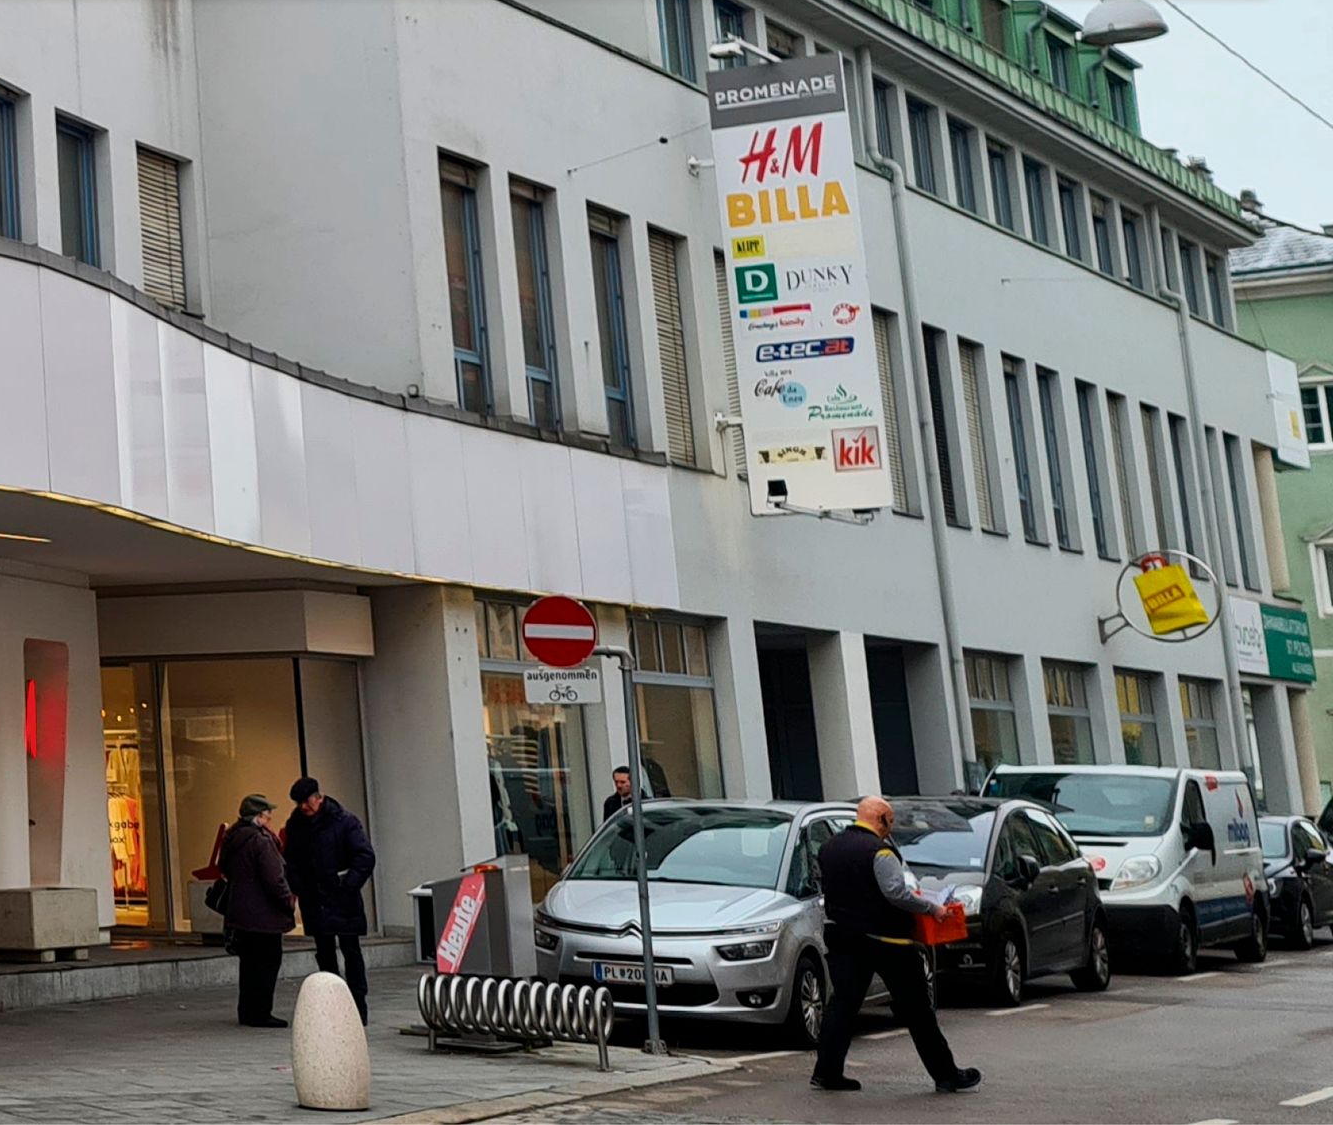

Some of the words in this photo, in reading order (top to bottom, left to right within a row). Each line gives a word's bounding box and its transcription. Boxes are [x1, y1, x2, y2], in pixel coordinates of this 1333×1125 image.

[715, 75, 836, 105] PROMENADE
[739, 121, 823, 183] H&M
[726, 181, 850, 229] BILLA
[744, 269, 769, 293] D
[786, 265, 852, 290] DUNKY
[808, 405, 873, 421] Promenade
[840, 429, 875, 467] kik
[526, 671, 598, 682] ausgenommen
[438, 895, 477, 963] Heute
[604, 967, 618, 978] PL
